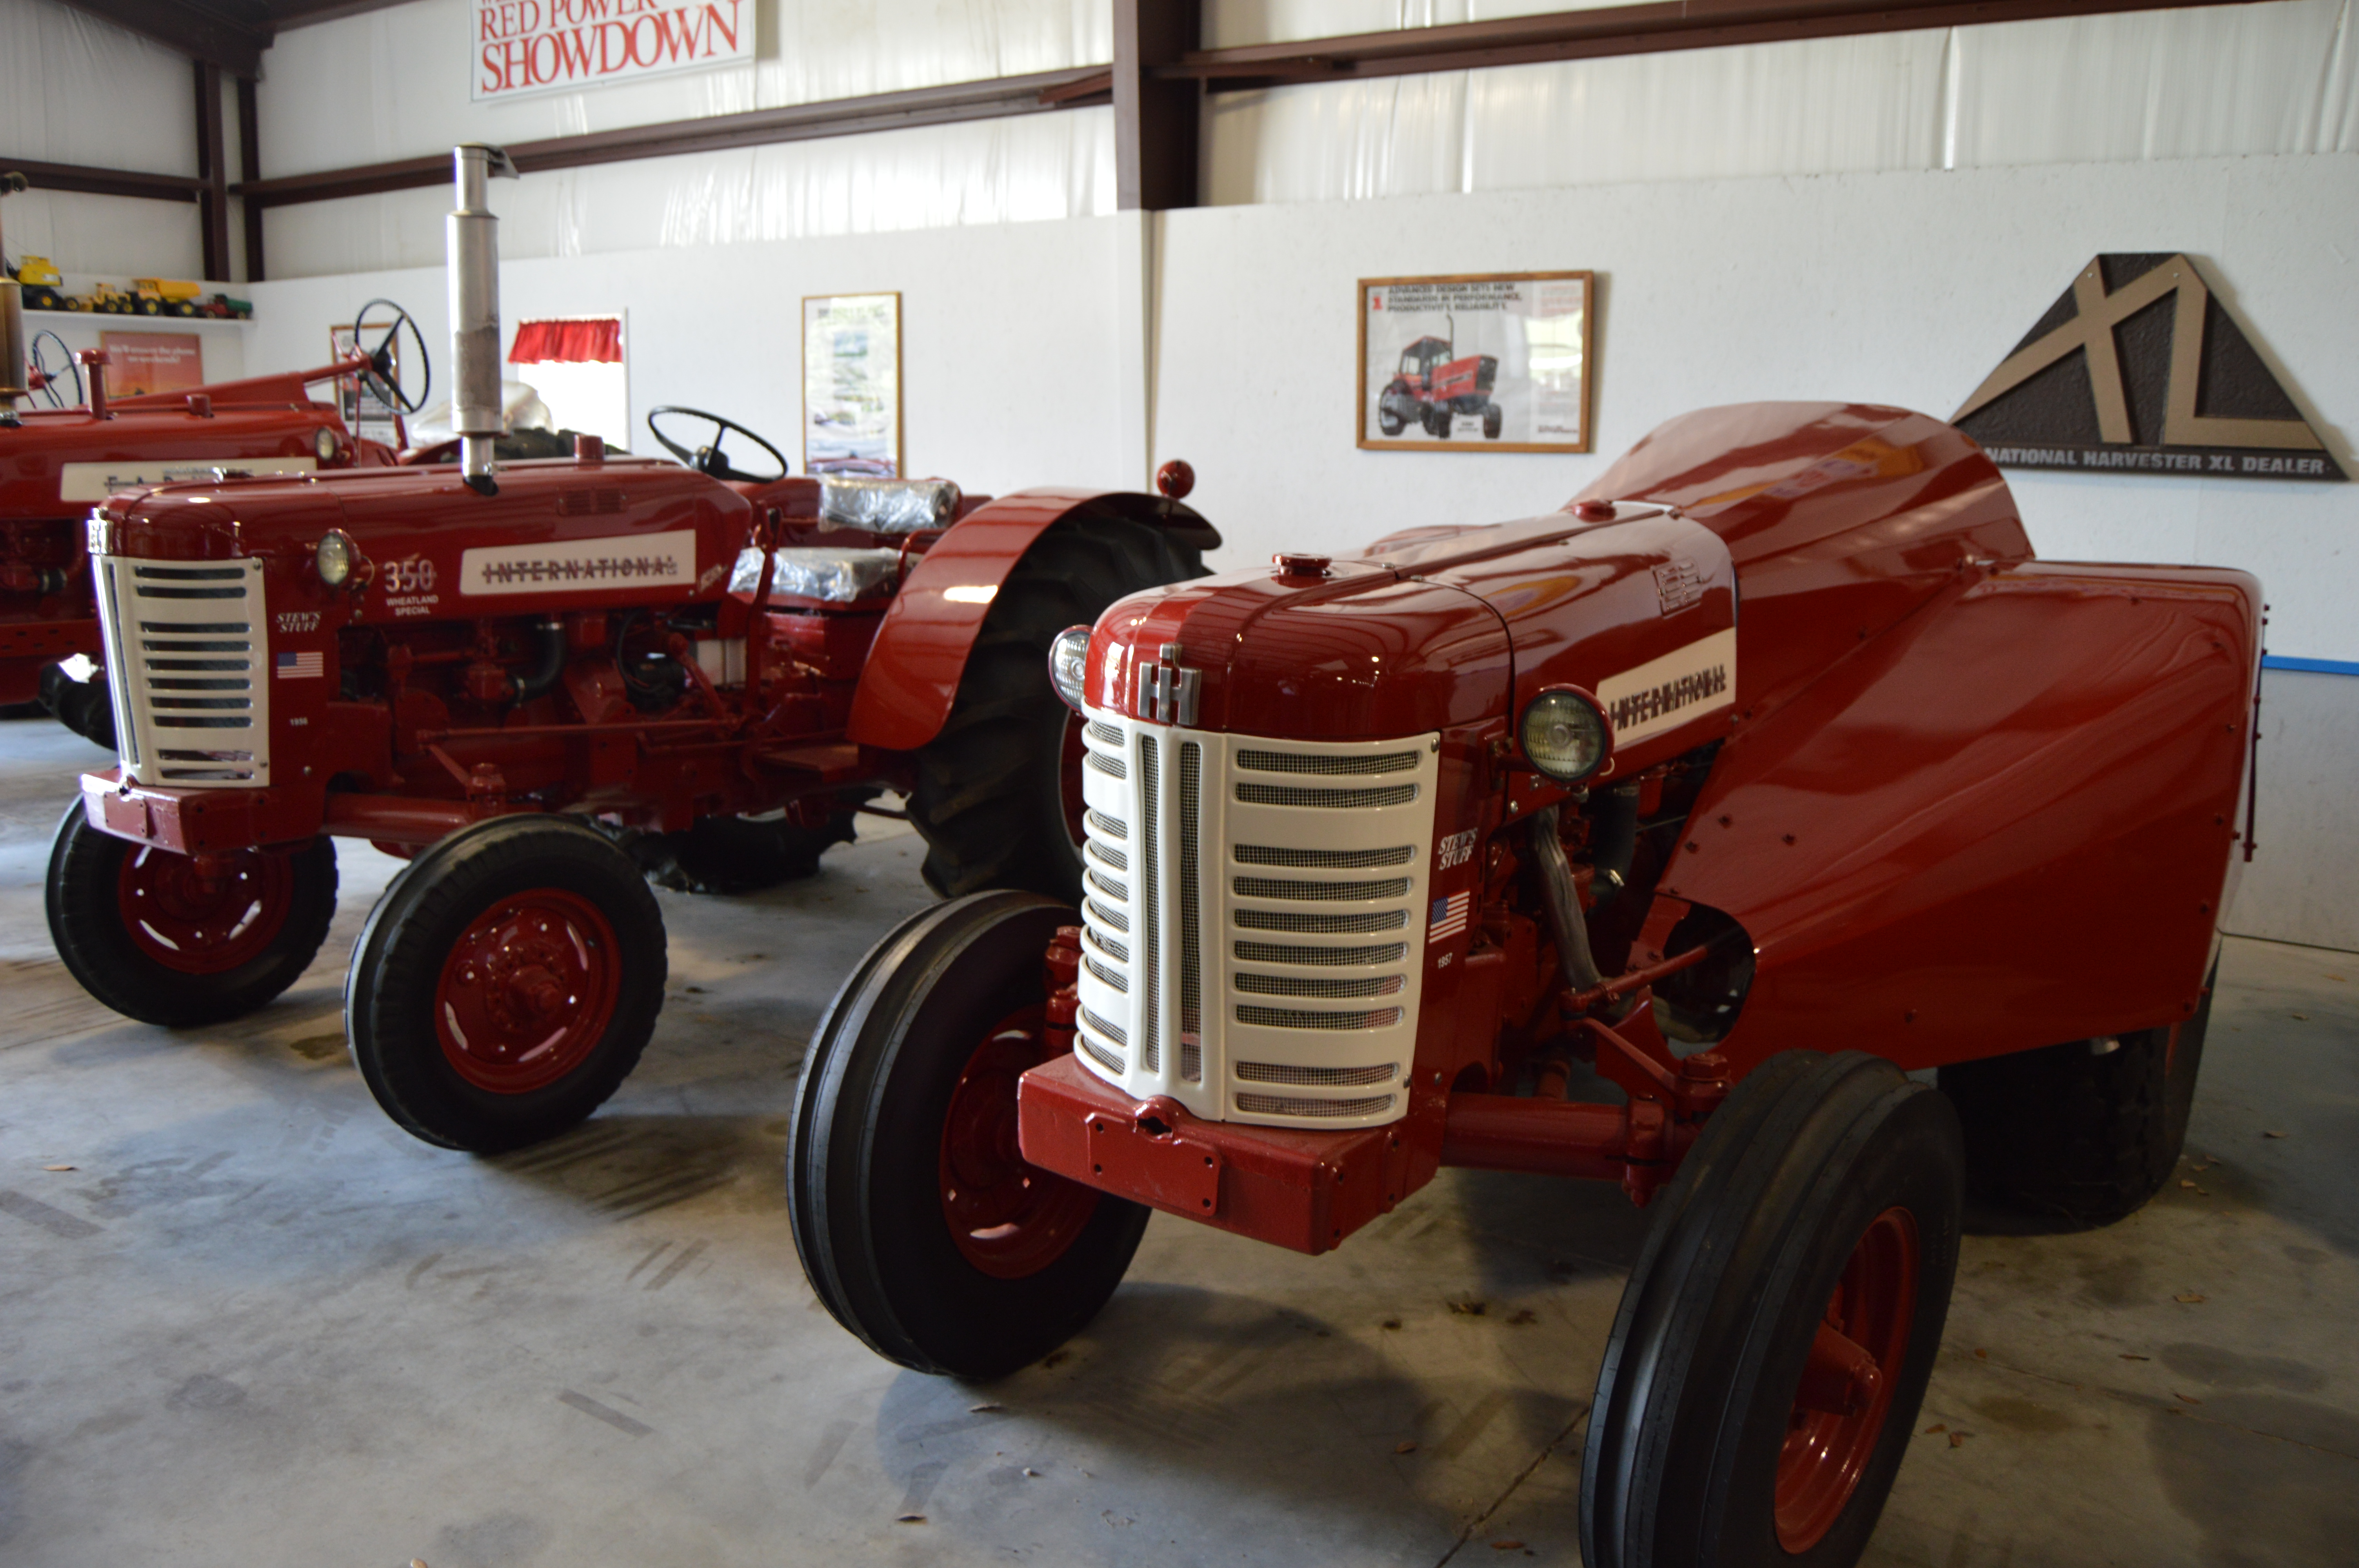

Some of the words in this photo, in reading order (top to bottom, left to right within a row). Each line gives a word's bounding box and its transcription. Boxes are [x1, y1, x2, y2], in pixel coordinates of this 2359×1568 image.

[479, 0, 540, 42] RED
[482, 0, 742, 94] SHOWDOWN
[2083, 450, 2202, 470] HARVESTER
[2208, 455, 2234, 470] XL
[2241, 456, 2325, 474] DEALER
[384, 559, 437, 593] 350
[386, 594, 439, 606] WHEATLAND
[395, 606, 430, 617] SPECIAL
[276, 611, 321, 624] STEW'S
[279, 621, 319, 633] STUFF
[1438, 827, 1478, 855] STEW'S
[1439, 845, 1474, 871] STUFF
[1438, 952, 1453, 969] 1957
